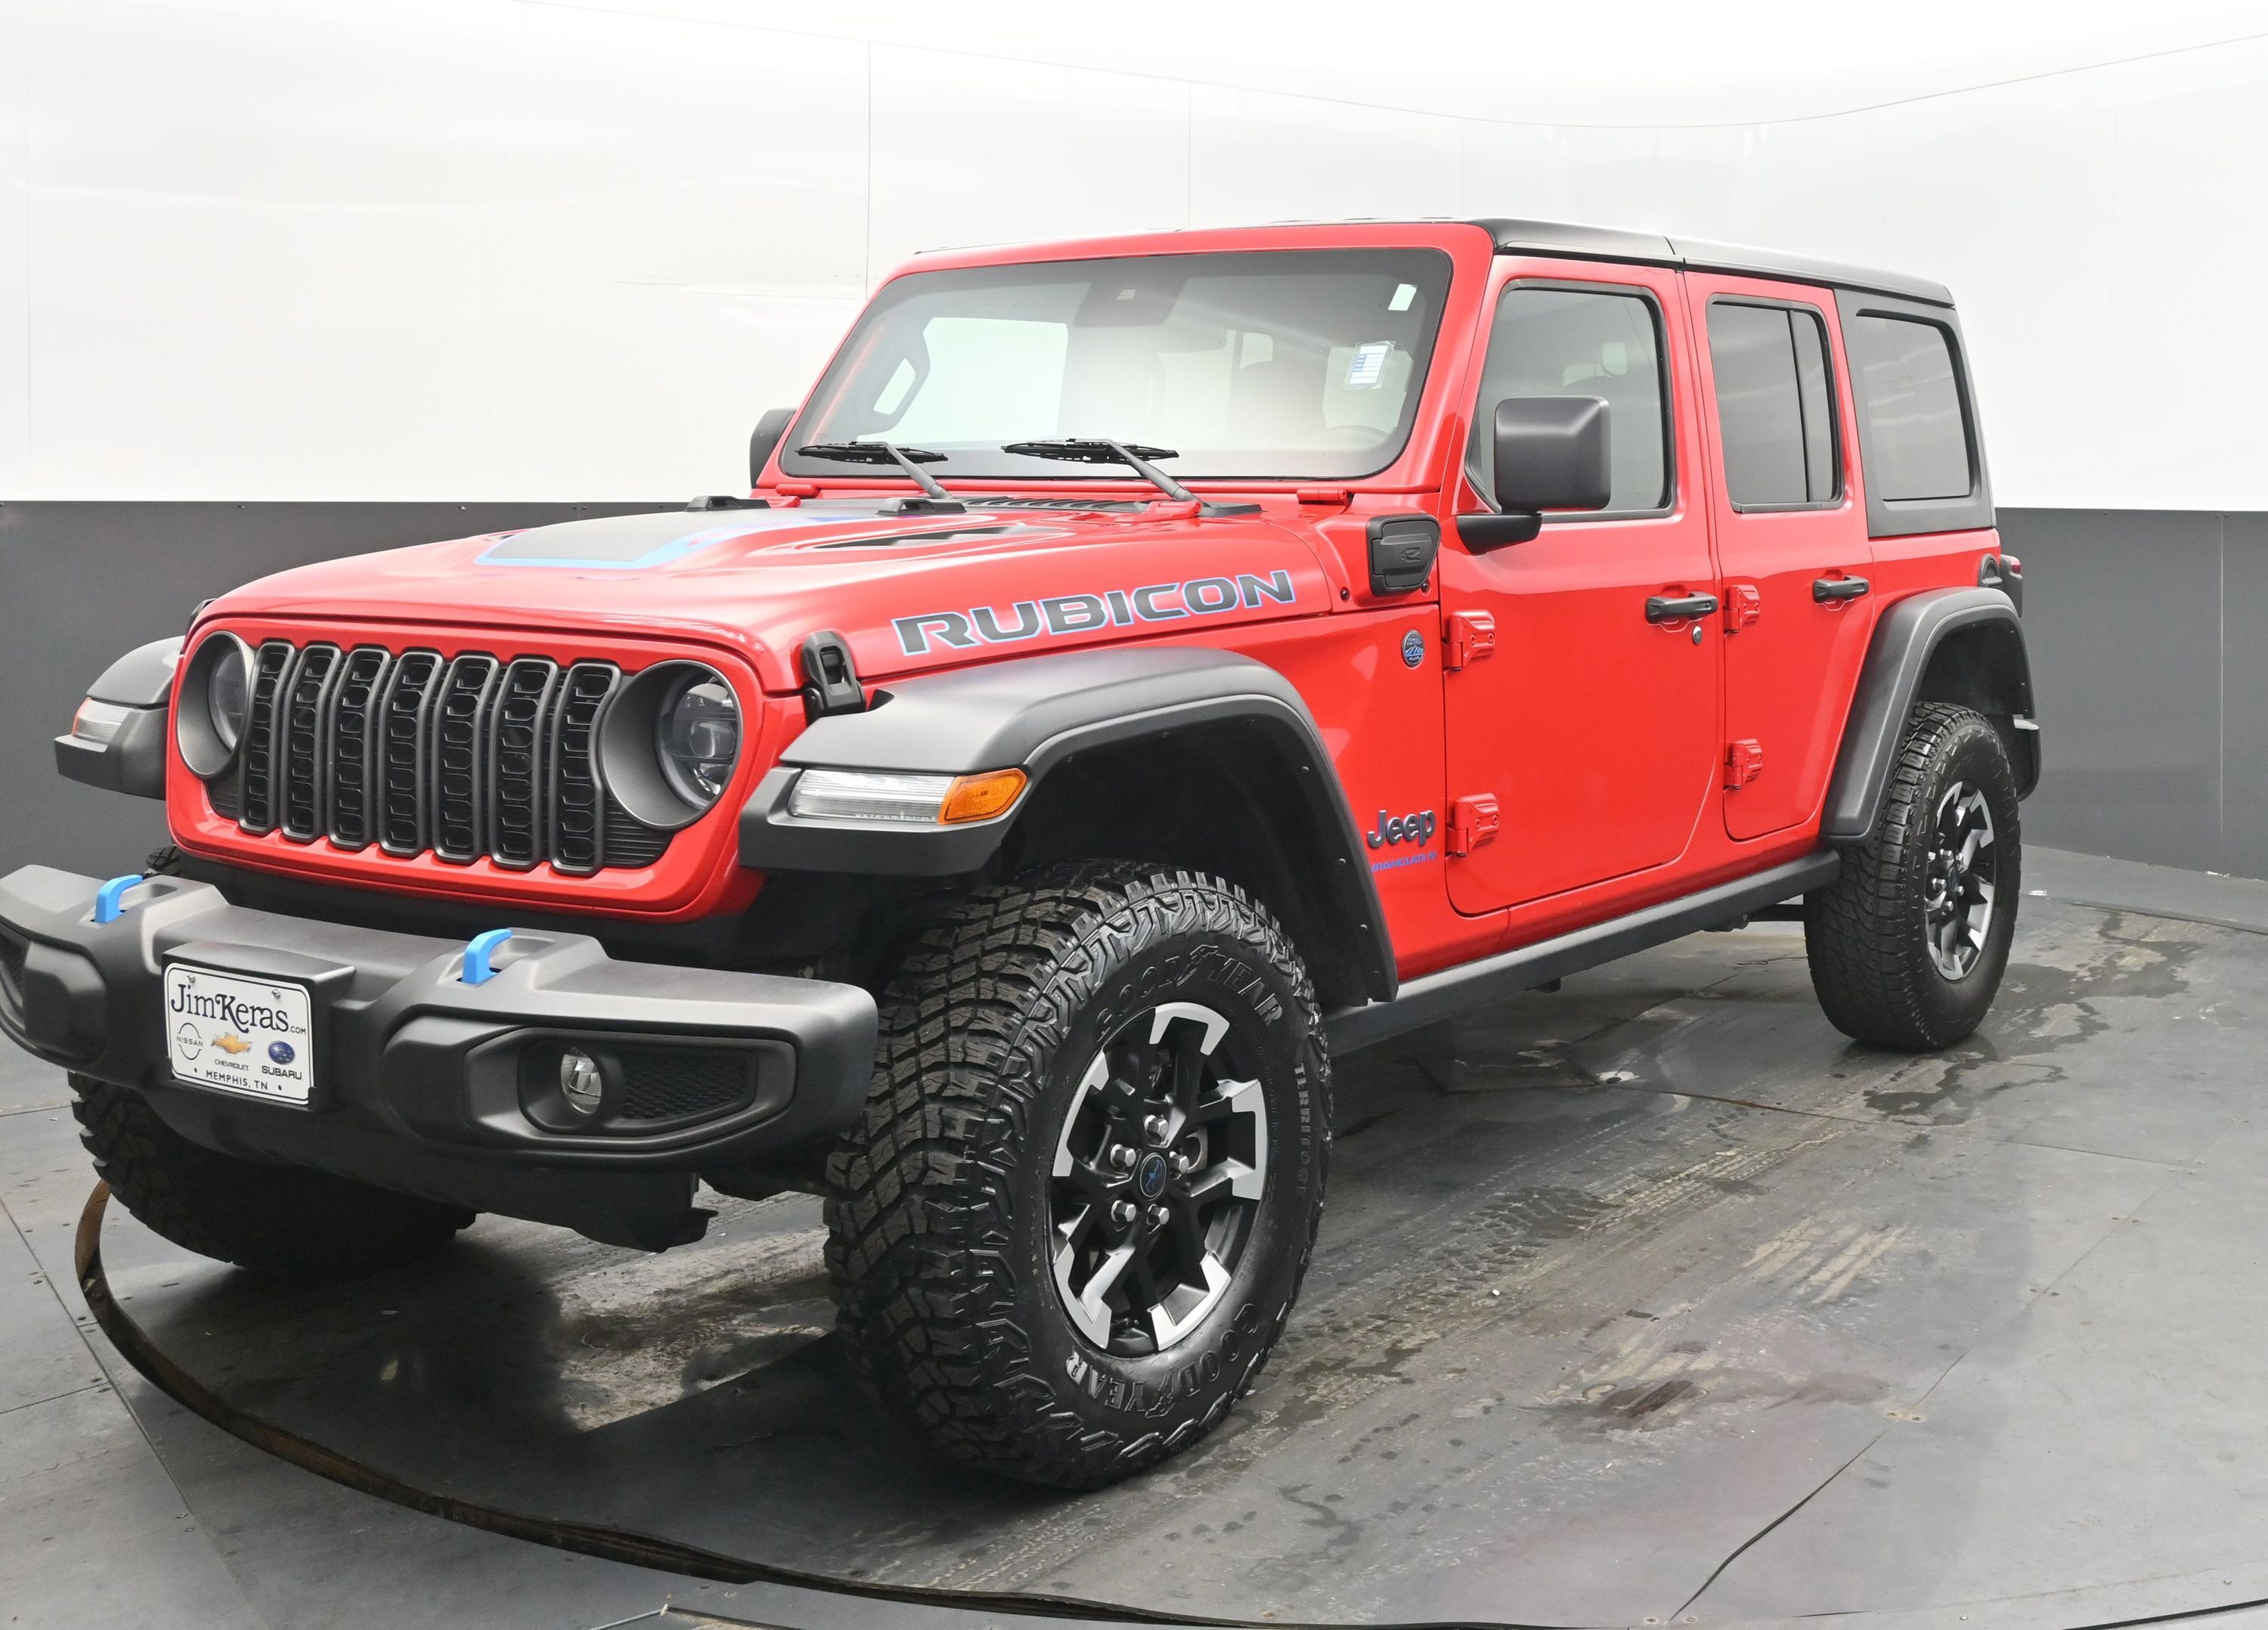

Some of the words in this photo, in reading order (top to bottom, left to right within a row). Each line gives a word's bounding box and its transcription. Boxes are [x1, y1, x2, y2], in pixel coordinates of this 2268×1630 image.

[891, 569, 1296, 656] RUBICON
[1367, 810, 1435, 849] Jeep
[176, 1035, 203, 1047] NISSAN
[215, 1058, 249, 1071] CHEVROLET
[262, 1065, 302, 1080] SUBARU
[206, 1070, 251, 1088] MEMPHIS,
[254, 1080, 268, 1090] TN
